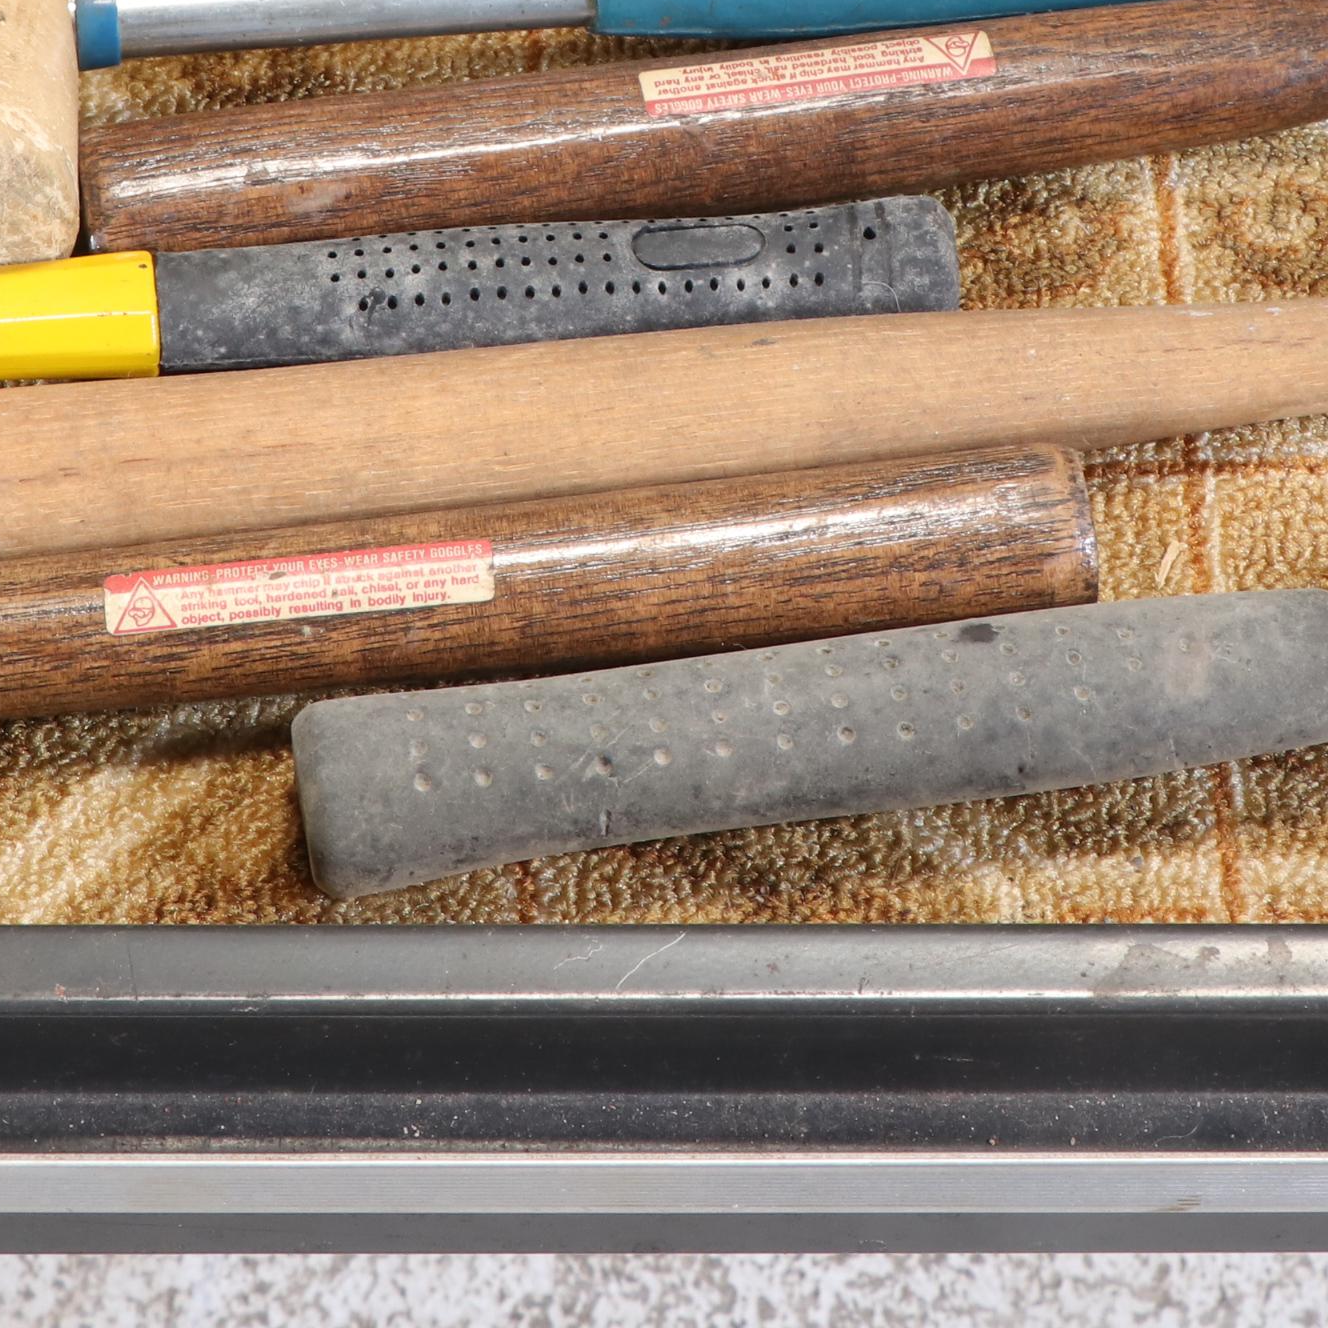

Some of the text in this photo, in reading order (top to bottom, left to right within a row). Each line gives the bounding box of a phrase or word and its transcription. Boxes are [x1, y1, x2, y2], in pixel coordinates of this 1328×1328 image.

[831, 45, 878, 56] possibly
[881, 47, 922, 57] striking
[776, 51, 825, 63] resulting
[903, 56, 924, 64] Any
[720, 61, 754, 71] bodily
[792, 57, 847, 71] hardened
[854, 58, 901, 71] hammer
[800, 68, 823, 79] chip
[827, 65, 850, 76] may
[654, 78, 680, 87] hard
[684, 75, 705, 84] any
[706, 77, 748, 91] against
[657, 84, 701, 96] another
[816, 81, 847, 93] YOUR
[655, 98, 703, 114] GOGGLES
[708, 93, 746, 109] SAFETY
[273, 561, 304, 572] YOUR
[383, 549, 425, 563] SAFETY
[180, 590, 204, 602] Any
[208, 583, 259, 597] hammer
[263, 580, 289, 592] may
[293, 576, 320, 590] chip
[429, 563, 477, 576] another
[180, 600, 228, 613] striking
[234, 595, 262, 608] tool,
[266, 588, 326, 603] hardened
[362, 582, 402, 594] chisel,
[406, 581, 419, 590] or
[424, 579, 446, 590] any
[451, 574, 480, 585] hard
[181, 589, 451, 625] object, possibly resulting in bodily injury.
